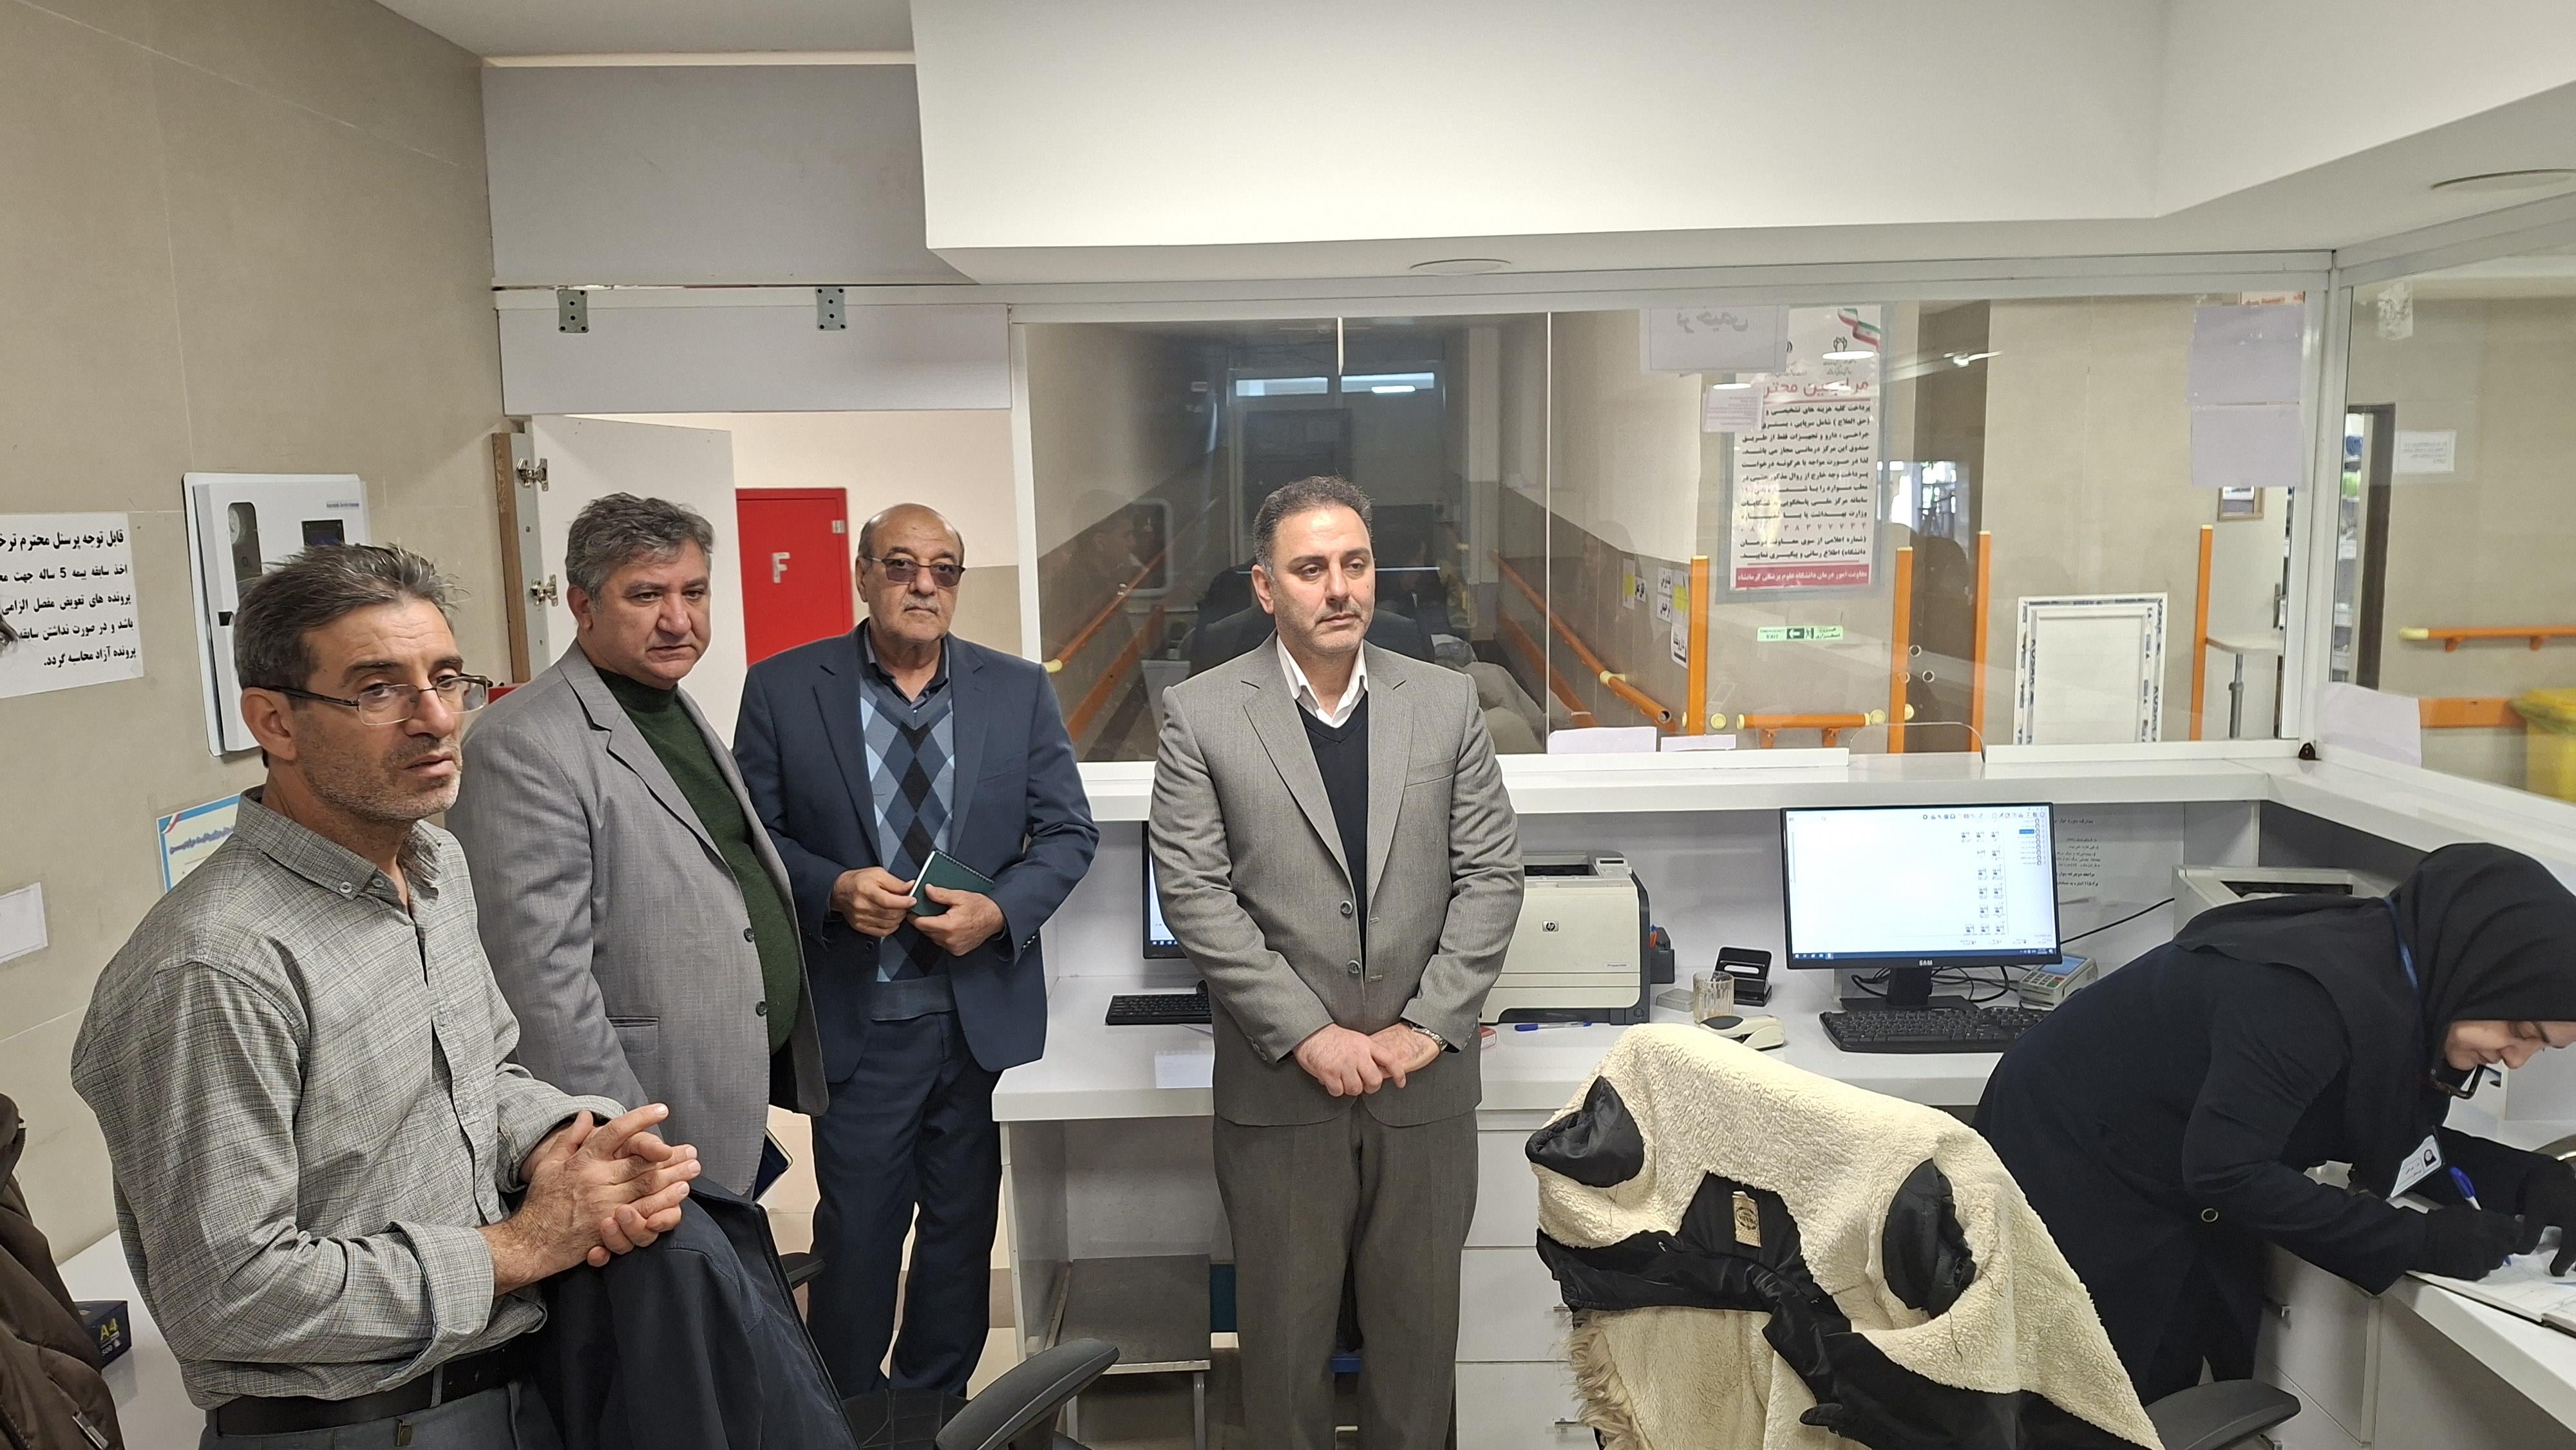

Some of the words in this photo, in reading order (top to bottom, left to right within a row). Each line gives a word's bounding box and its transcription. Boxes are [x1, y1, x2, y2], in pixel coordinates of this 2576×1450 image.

[1763, 381, 1798, 398] محتر
[1803, 406, 1815, 415] های
[1817, 406, 1832, 414] هزینه
[1834, 404, 1846, 413] کلیه
[1848, 404, 1870, 413] پرداخت
[1816, 418, 1831, 428] شامل
[1741, 434, 1768, 444] طریق
[1822, 444, 1836, 454] مرکز
[20, 533, 50, 551] محترم
[53, 531, 80, 550] پرسنل
[82, 531, 104, 549] توجه
[106, 529, 124, 547] قابل
[39, 568, 55, 579] ساله
[60, 567, 66, 578] 5
[72, 569, 86, 581] بیمه
[91, 565, 109, 579] سابقه
[114, 563, 128, 575] اخذ
[772, 552, 791, 583] F
[14, 571, 33, 584] جهت
[33, 597, 55, 612] مفصل
[59, 594, 84, 610] تعویض
[89, 593, 104, 608] های
[108, 591, 131, 606] پرونده
[1, 598, 28, 616] الزامی
[72, 623, 95, 637] صورت
[99, 621, 107, 636] در
[111, 623, 115, 634] و
[118, 617, 133, 631] باشد
[19, 627, 39, 642] سابقه
[43, 623, 70, 641] نداشتن
[68, 650, 93, 666] محاسبه
[96, 645, 111, 663] آزاد
[113, 645, 136, 659] پرونده
[43, 653, 66, 668] گردد.
[100, 1317, 118, 1341] A4
